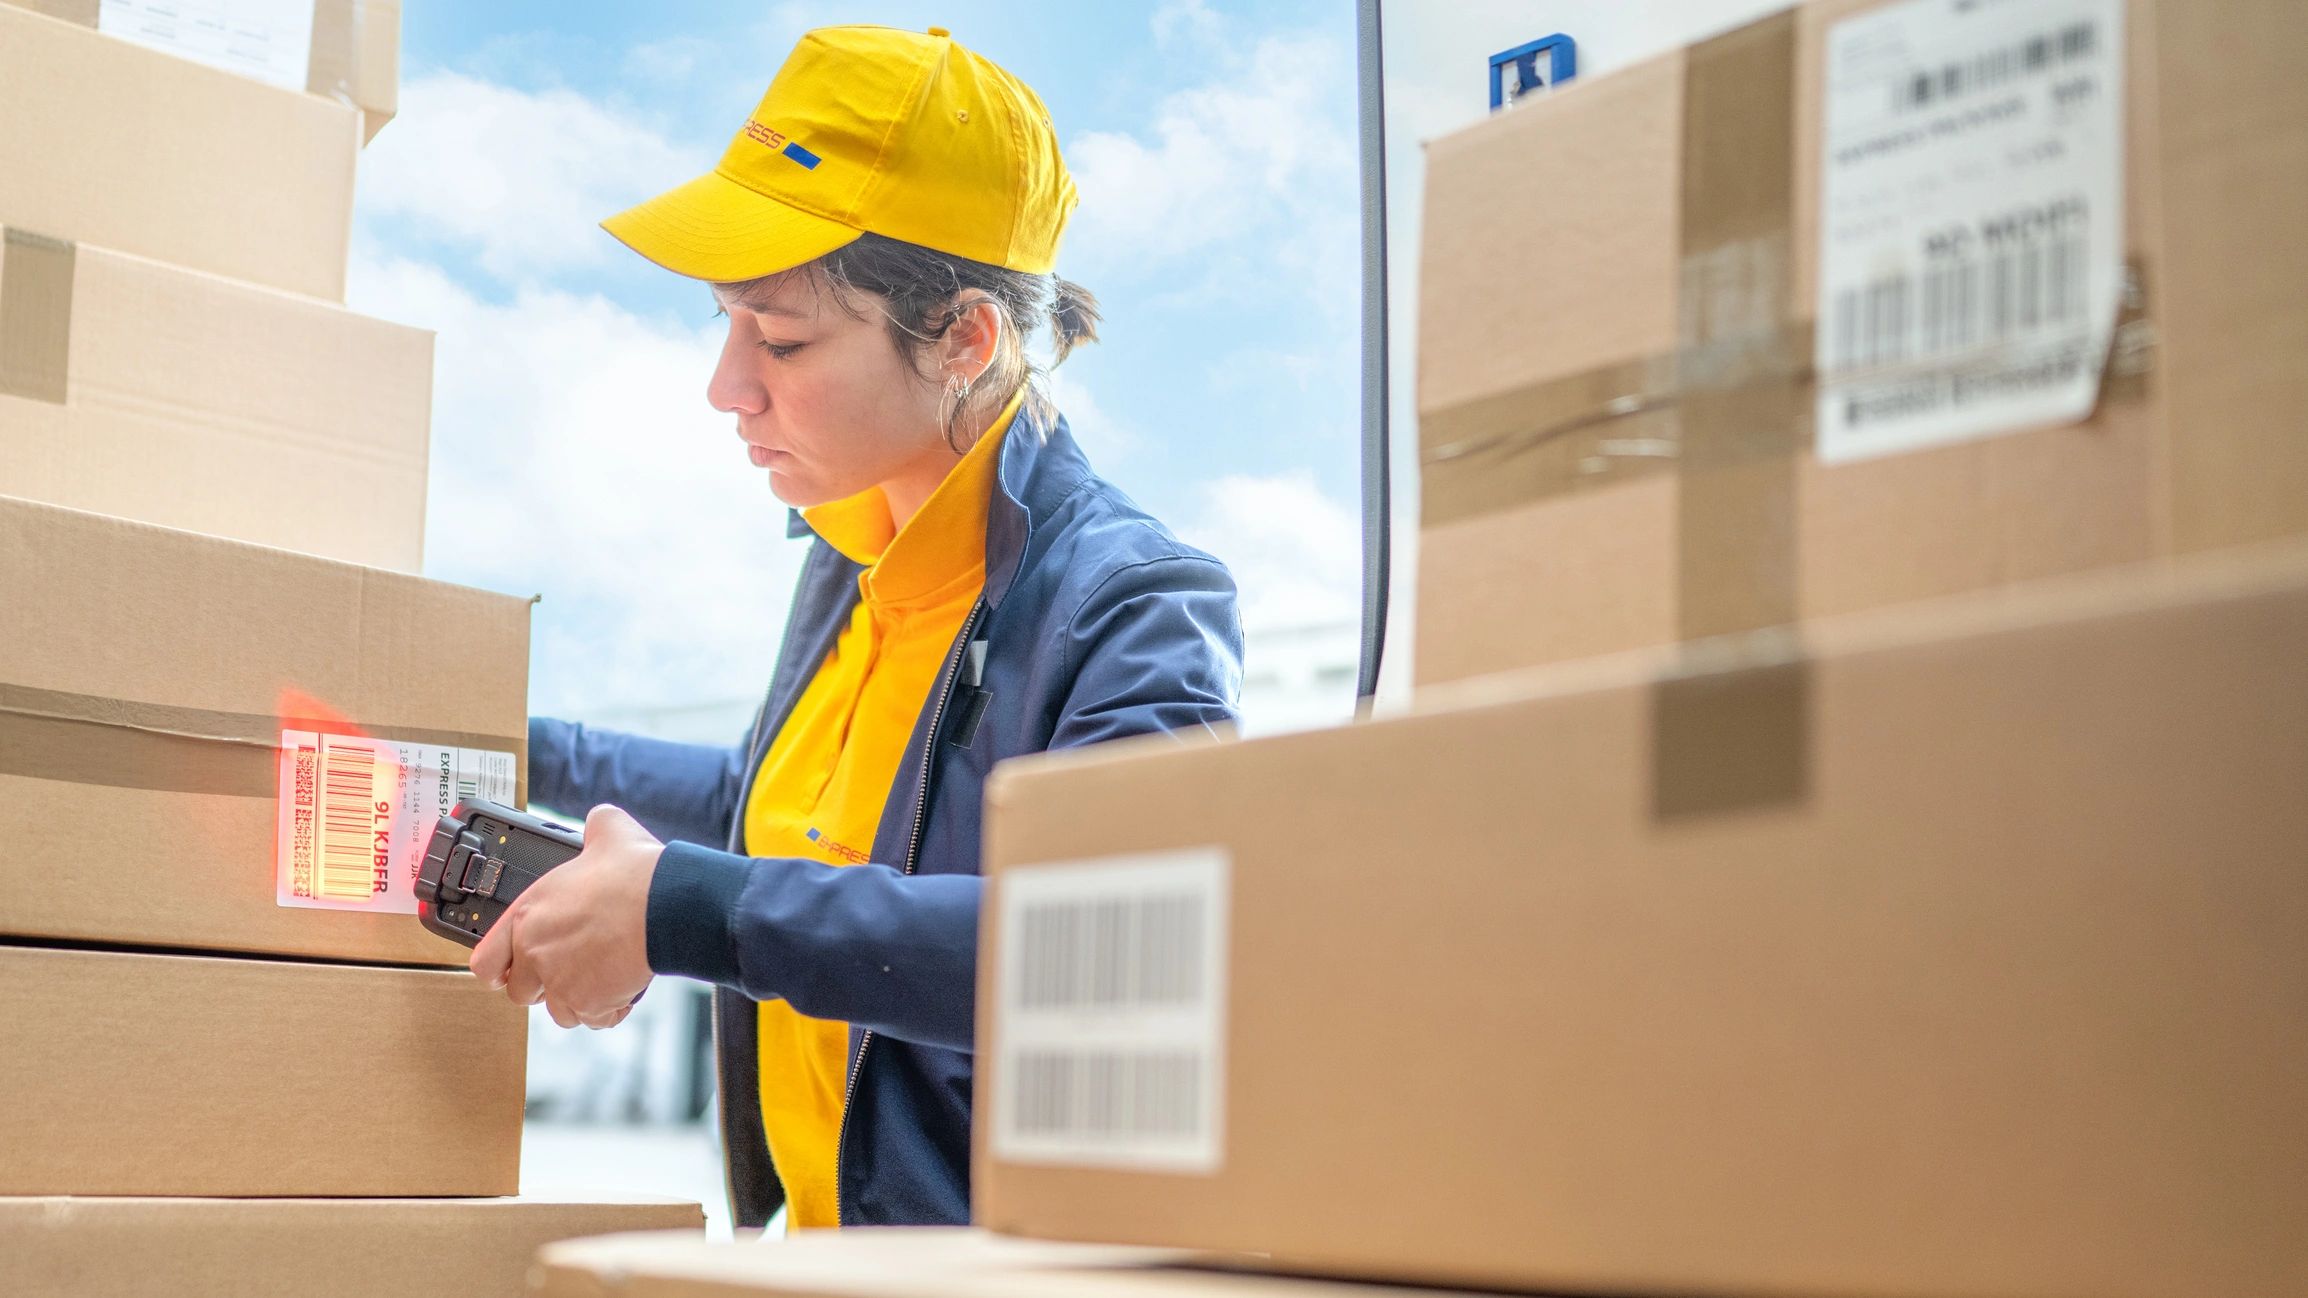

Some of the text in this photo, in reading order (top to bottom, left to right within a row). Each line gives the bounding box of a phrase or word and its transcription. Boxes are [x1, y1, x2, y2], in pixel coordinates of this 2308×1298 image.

[398, 748, 409, 788] 18265
[414, 762, 422, 785] 9276
[438, 752, 450, 818] EXPRESS P
[413, 791, 421, 814] 1144
[373, 801, 389, 893] 9L KJBFR
